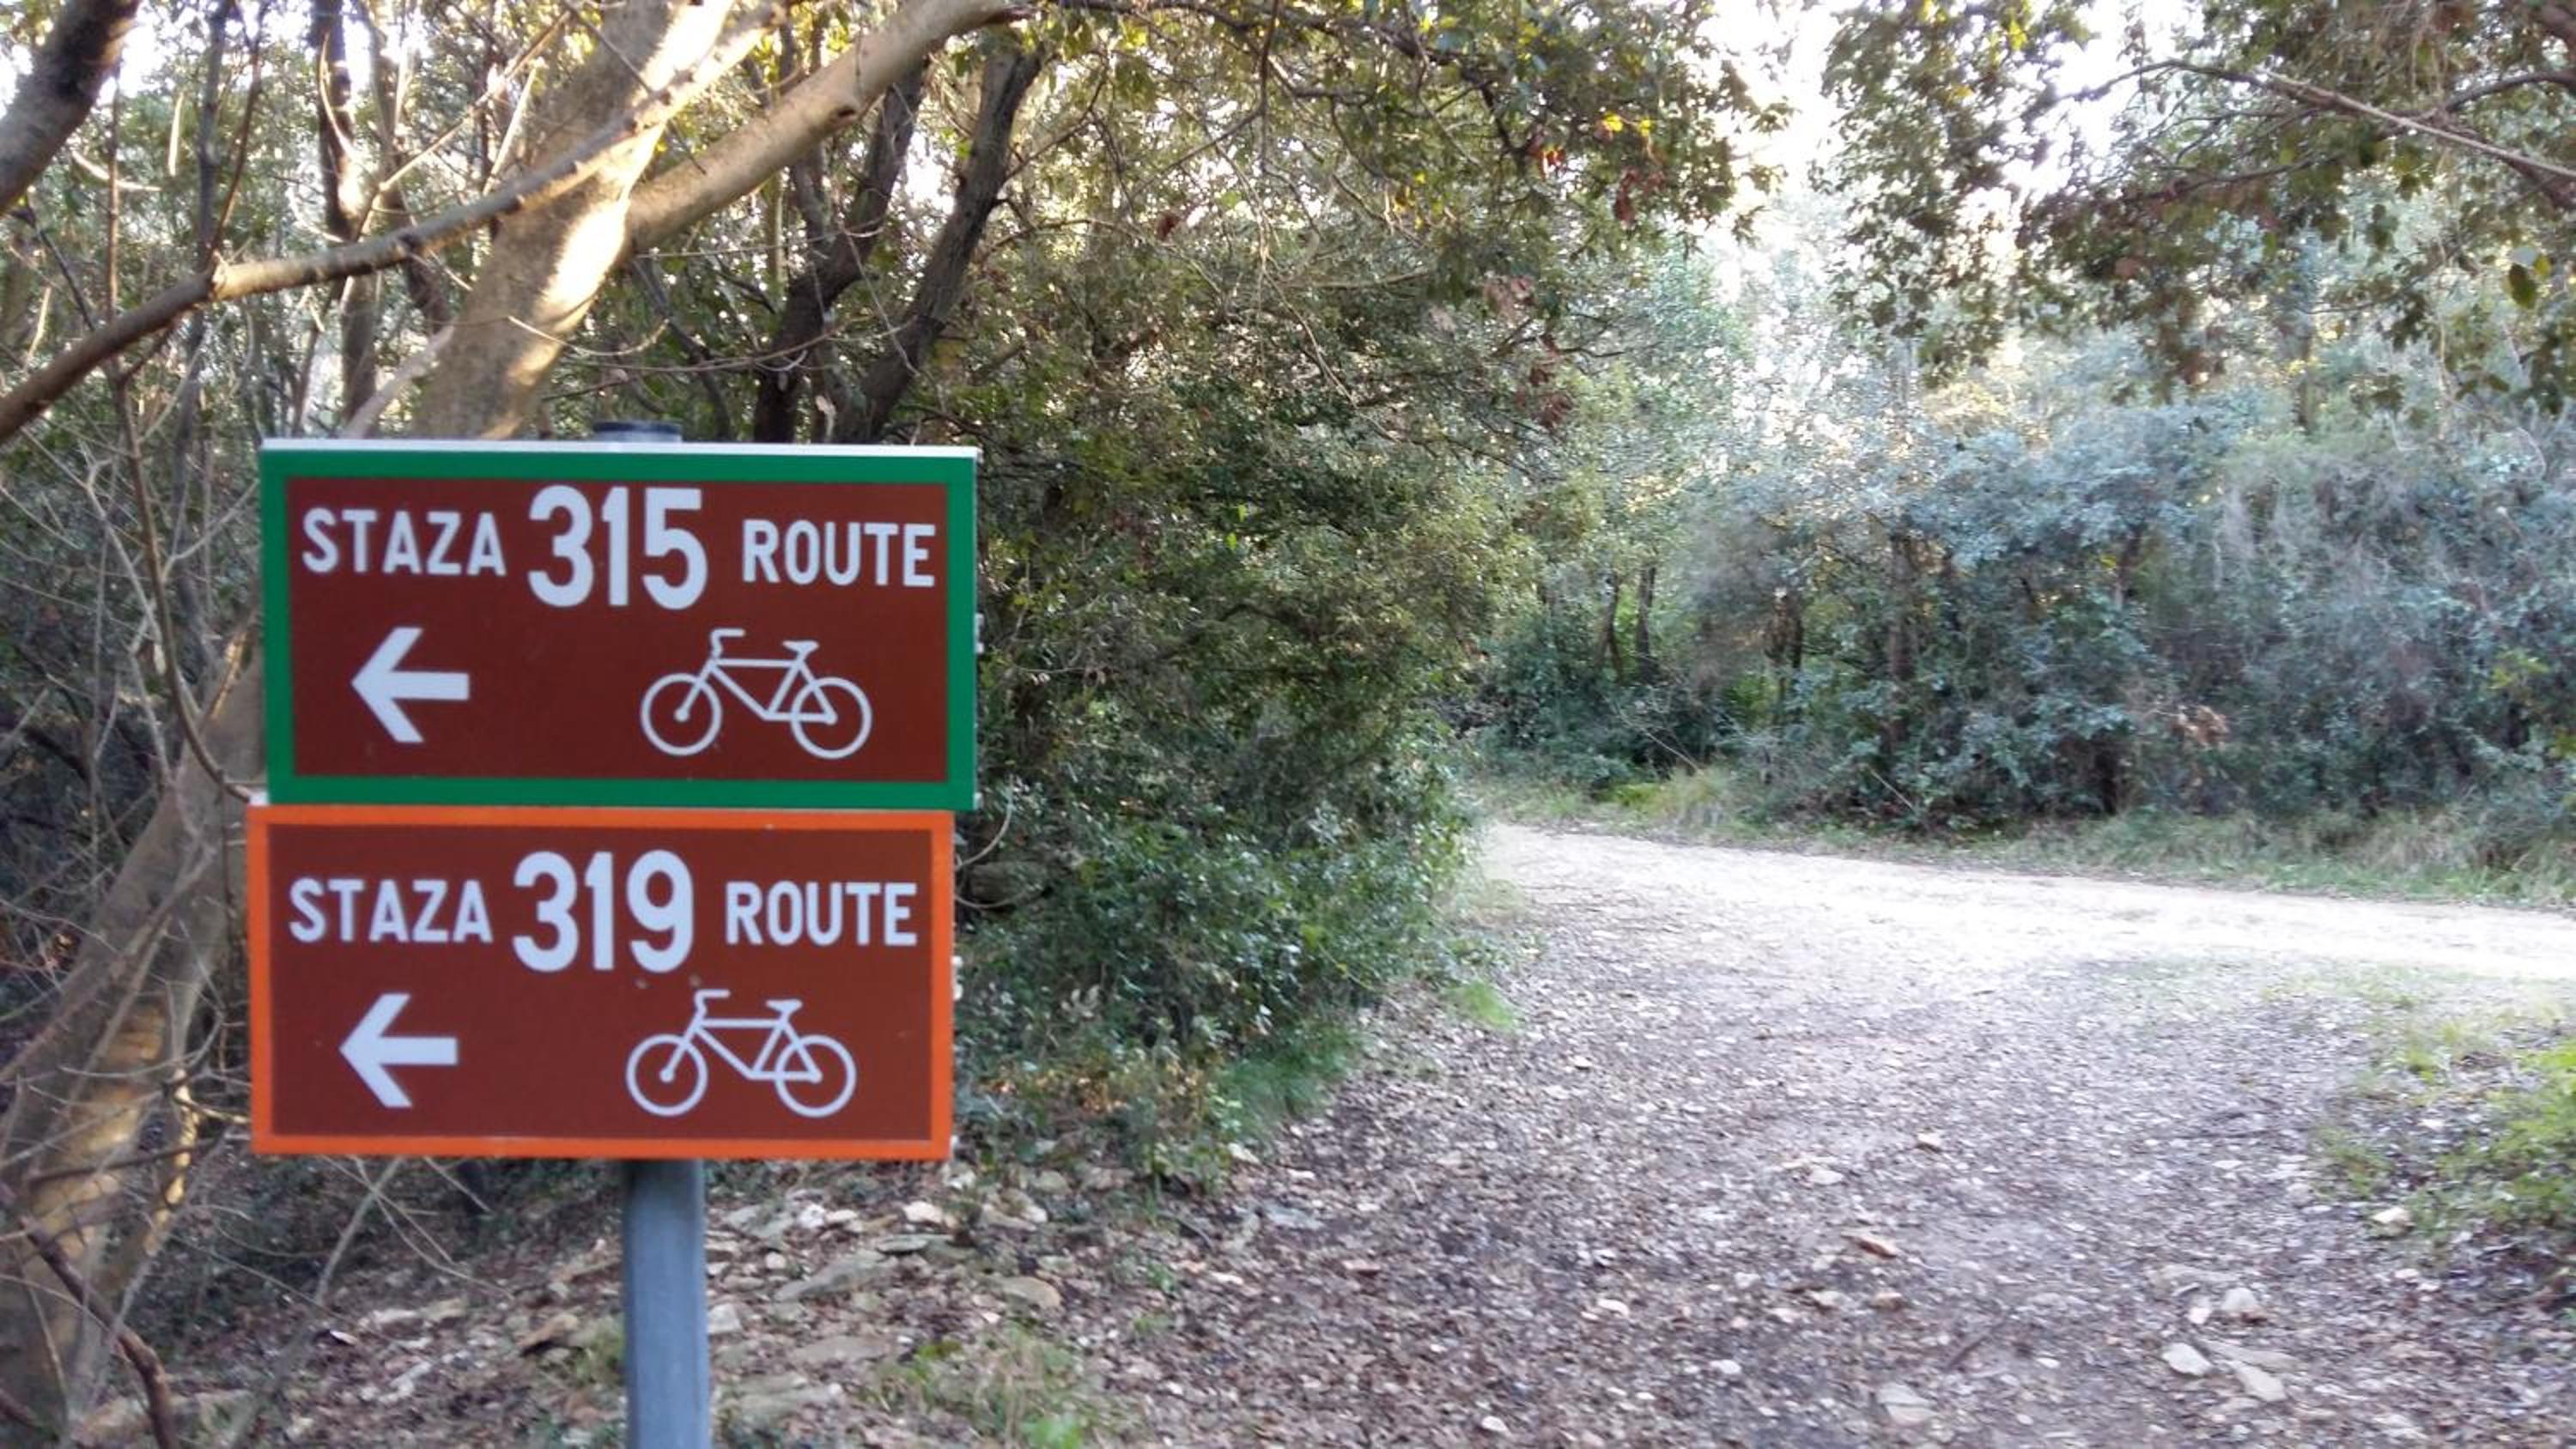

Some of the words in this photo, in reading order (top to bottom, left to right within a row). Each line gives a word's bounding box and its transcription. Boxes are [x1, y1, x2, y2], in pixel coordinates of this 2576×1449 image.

[303, 507, 506, 576] STAZA
[528, 485, 708, 609] 315
[743, 518, 936, 587] ROUTE
[289, 877, 493, 943] STAZA
[513, 849, 694, 973] 319
[726, 881, 917, 946] ROUTE
